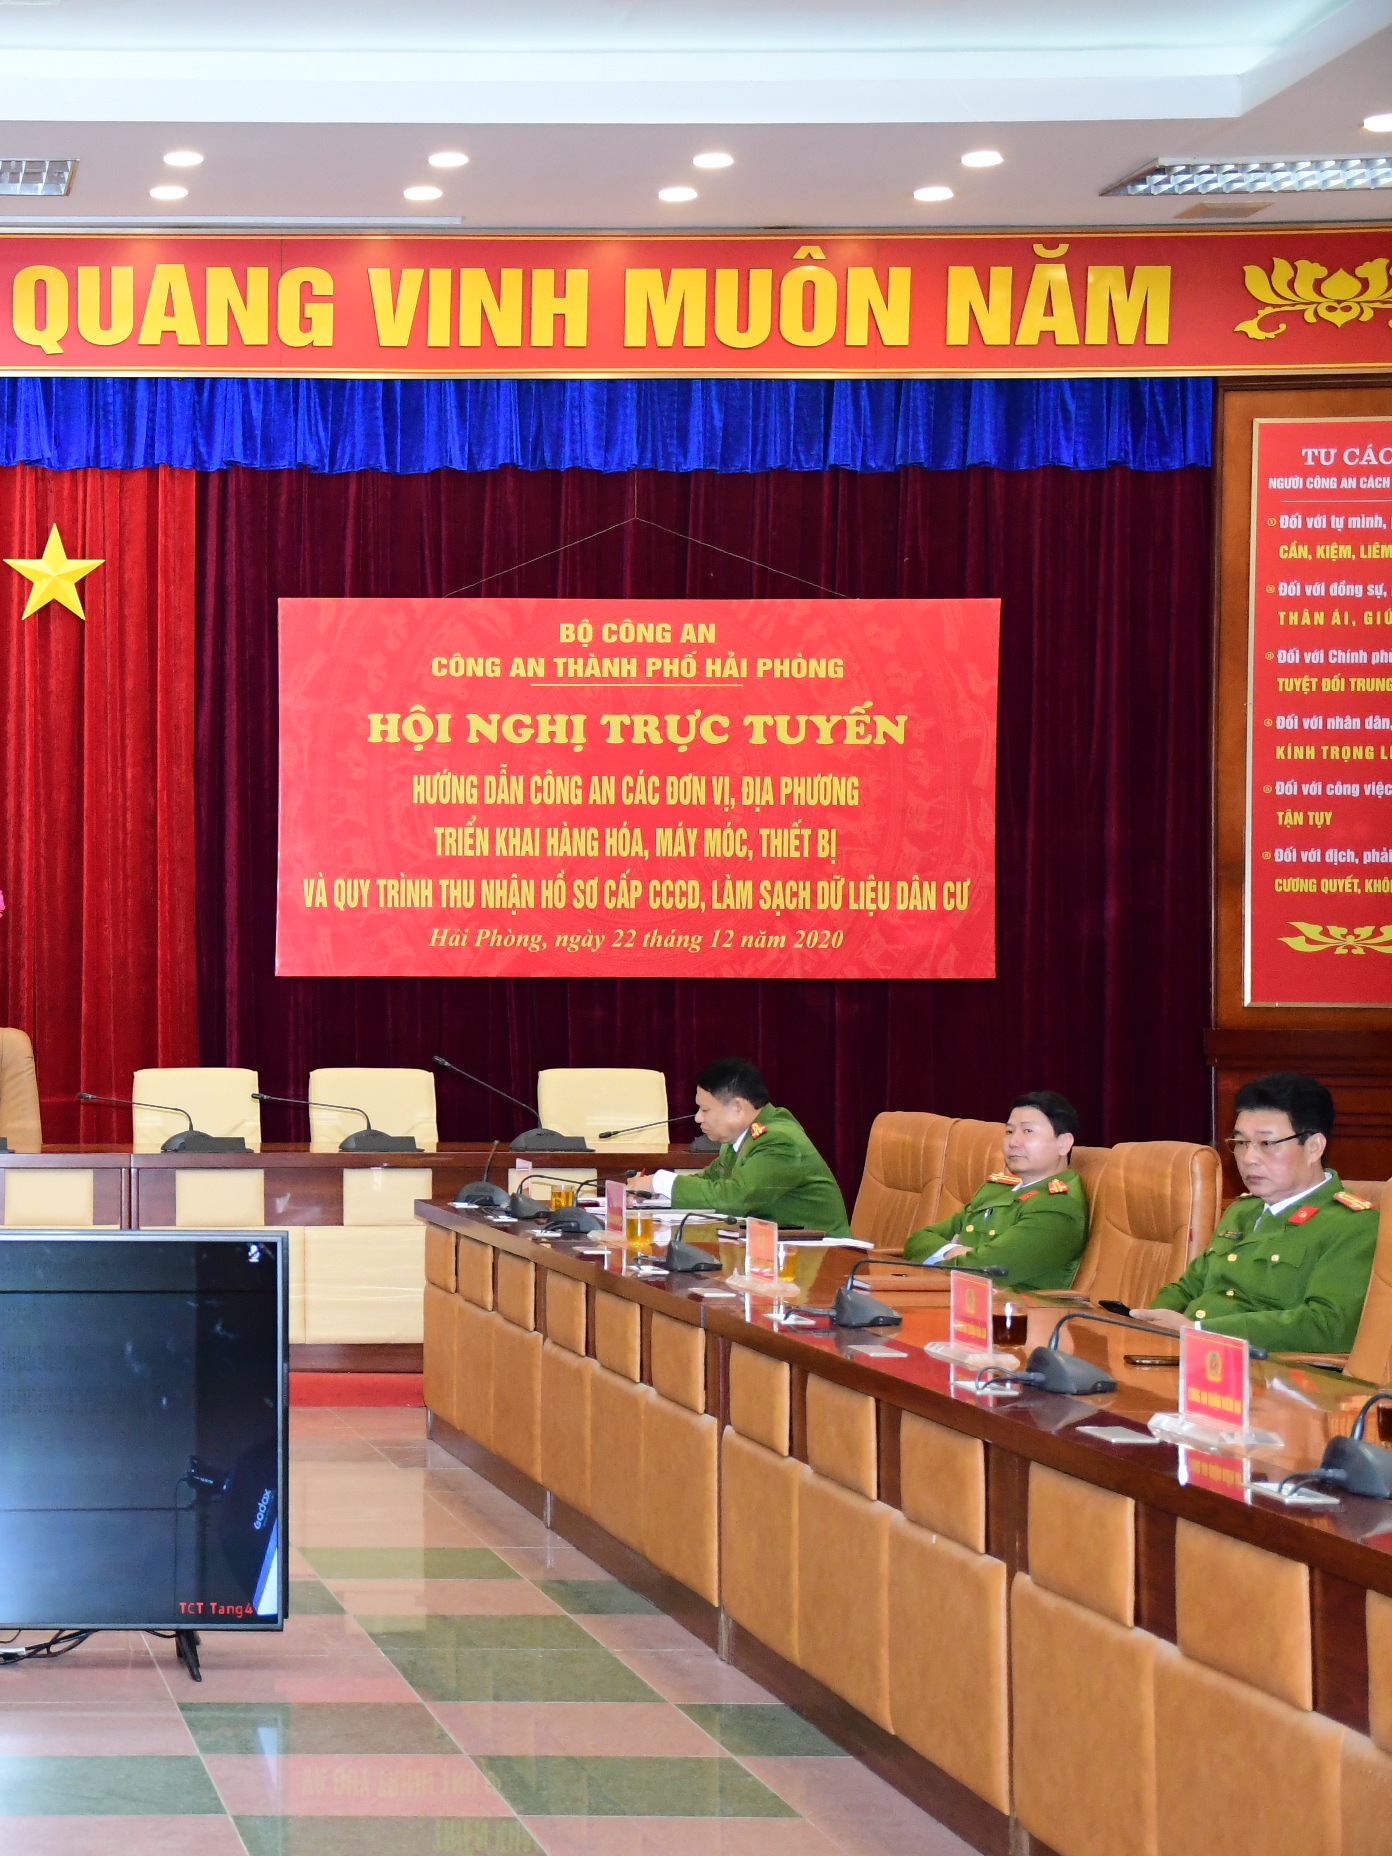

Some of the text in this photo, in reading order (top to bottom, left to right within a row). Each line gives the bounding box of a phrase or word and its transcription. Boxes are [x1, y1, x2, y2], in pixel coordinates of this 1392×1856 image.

[13, 263, 334, 355] QUANG
[368, 268, 589, 348] VINH
[624, 246, 912, 348] MUÔN
[946, 244, 1172, 346] NĂM
[1302, 448, 1337, 465] TƯ
[1269, 475, 1390, 489] NGƯỜI CÔNG AN CÁCH
[1280, 513, 1302, 528] Đối
[1306, 514, 1326, 528] với
[1331, 515, 1345, 531] tự
[1348, 514, 1386, 529] mình,
[1279, 541, 1392, 561] CẦN, KIỆM, LIÊM
[1278, 580, 1300, 596] Đối
[1305, 582, 1325, 596] với
[1329, 580, 1363, 597] đồng
[1367, 583, 1387, 598] sự,
[1278, 609, 1324, 625] THÂN
[1331, 609, 1356, 626] ÁI,
[560, 619, 715, 647] BỘ CÔNG AN
[432, 651, 843, 678] CÔNG AN THÀNH PHỐ HẢI PHÒNG
[1277, 648, 1299, 663] Đối
[1304, 649, 1324, 663] với
[1329, 649, 1367, 663] Chính
[1277, 675, 1318, 694] TUYỆT
[1321, 673, 1345, 691] ĐỐI
[367, 701, 907, 752] HỘI NGHỊ TRỰC TUYẾN
[1276, 714, 1298, 729] Đối
[1302, 715, 1322, 729] với
[1327, 715, 1360, 729] nhân
[1276, 743, 1315, 759] KÍNH
[1321, 746, 1374, 762] TRỌNG
[413, 764, 859, 812] HƯỚNG DẪN CÔNG AN CÁC ĐƠN VỊ, ĐỊA PHƯƠNG
[1275, 780, 1297, 795] Đối
[1302, 781, 1322, 795] với
[1326, 781, 1359, 797] công
[1277, 809, 1332, 828] TẬN TỤY
[434, 815, 836, 864] TRIỂN KHAI HÀNG HÓA, MÁY MÓC, THIẾT BỊ
[1274, 847, 1296, 862] Đối
[1301, 848, 1321, 862] với
[1325, 849, 1358, 865] địch,
[303, 869, 970, 916] VÀ QUY TRÌNH THU NHẬN HỒ SƠ CẤP CCCD, LÀM SẠCH DỮ LIỆU DÂN CƯ
[1275, 877, 1317, 892] CƯƠNG
[1321, 875, 1361, 894] QUYẾT,
[429, 929, 843, 952] Hải Phòng, ngày 22 tháng 12 năm 2020
[254, 1489, 271, 1530] Godox
[180, 1602, 253, 1618] TCT Tang4
